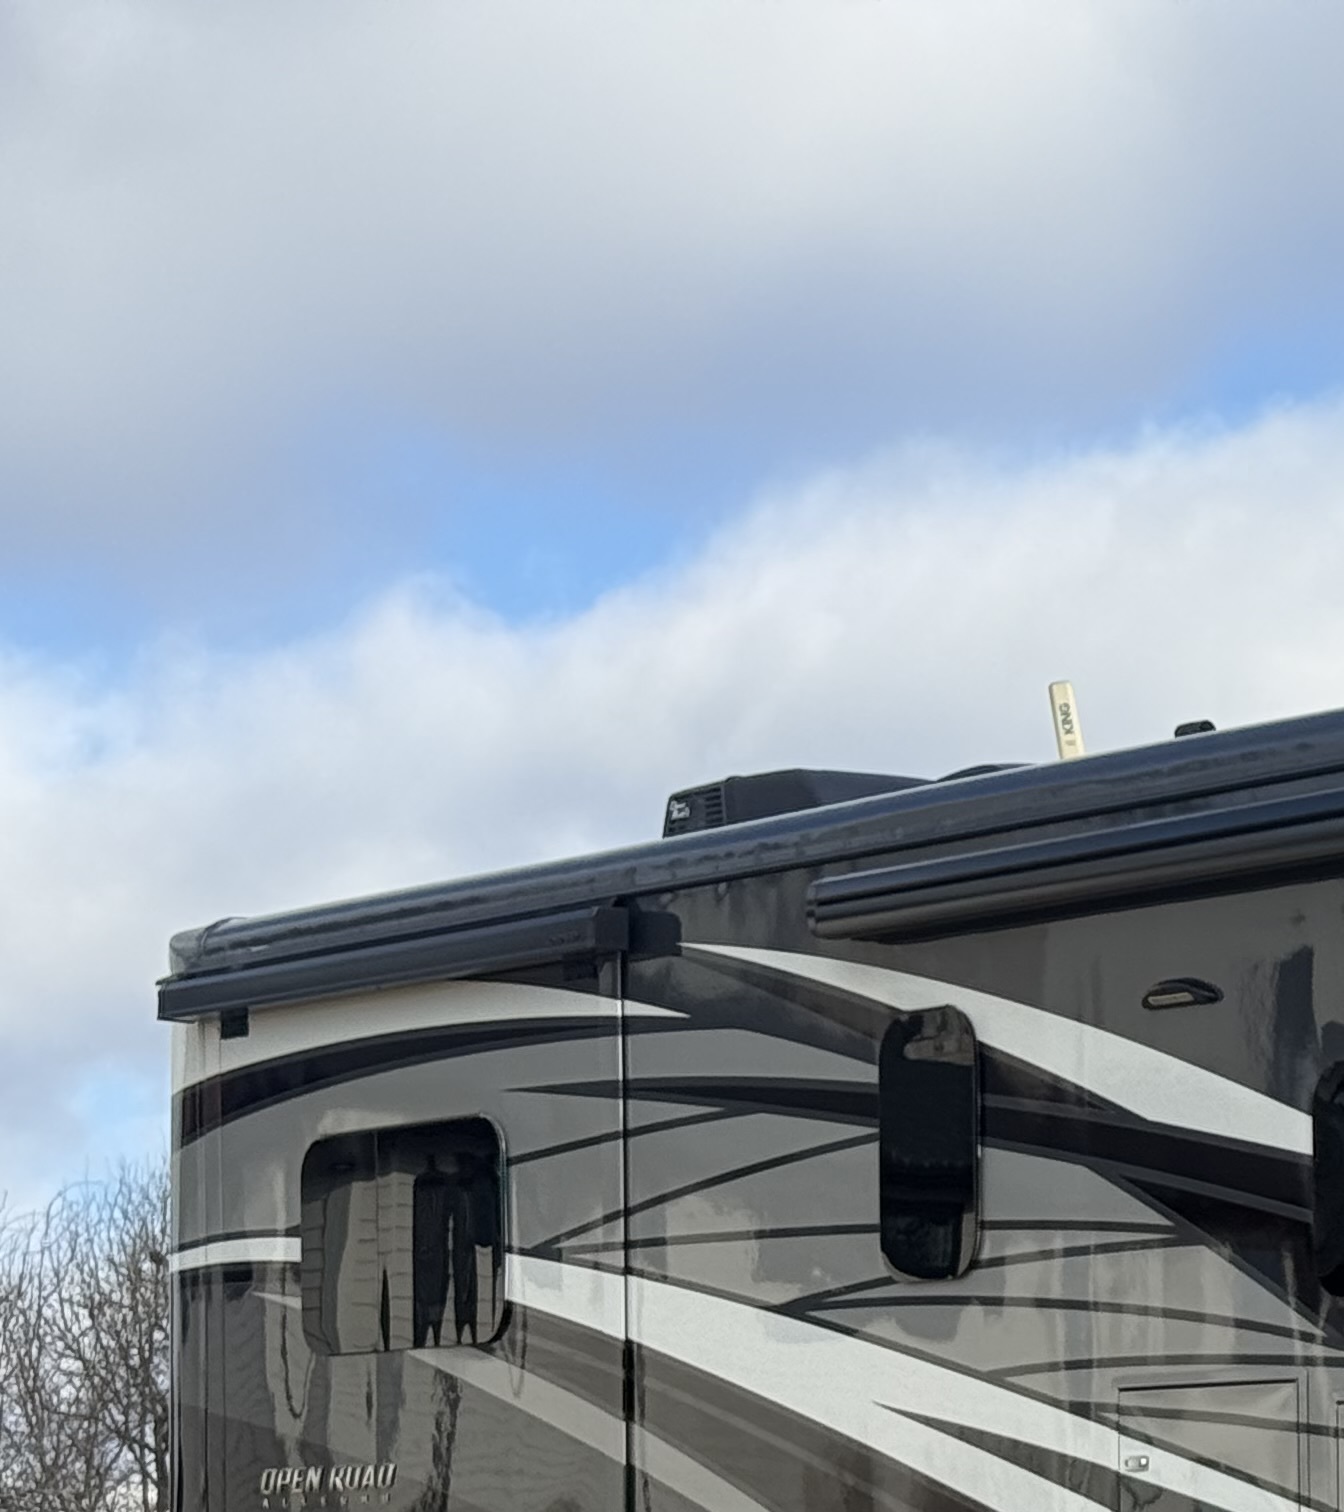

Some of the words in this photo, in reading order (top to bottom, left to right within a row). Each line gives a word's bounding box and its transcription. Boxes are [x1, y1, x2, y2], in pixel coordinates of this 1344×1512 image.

[1058, 702, 1075, 736] KING
[260, 1465, 325, 1495] OPEN
[329, 1462, 398, 1492] ROAD
